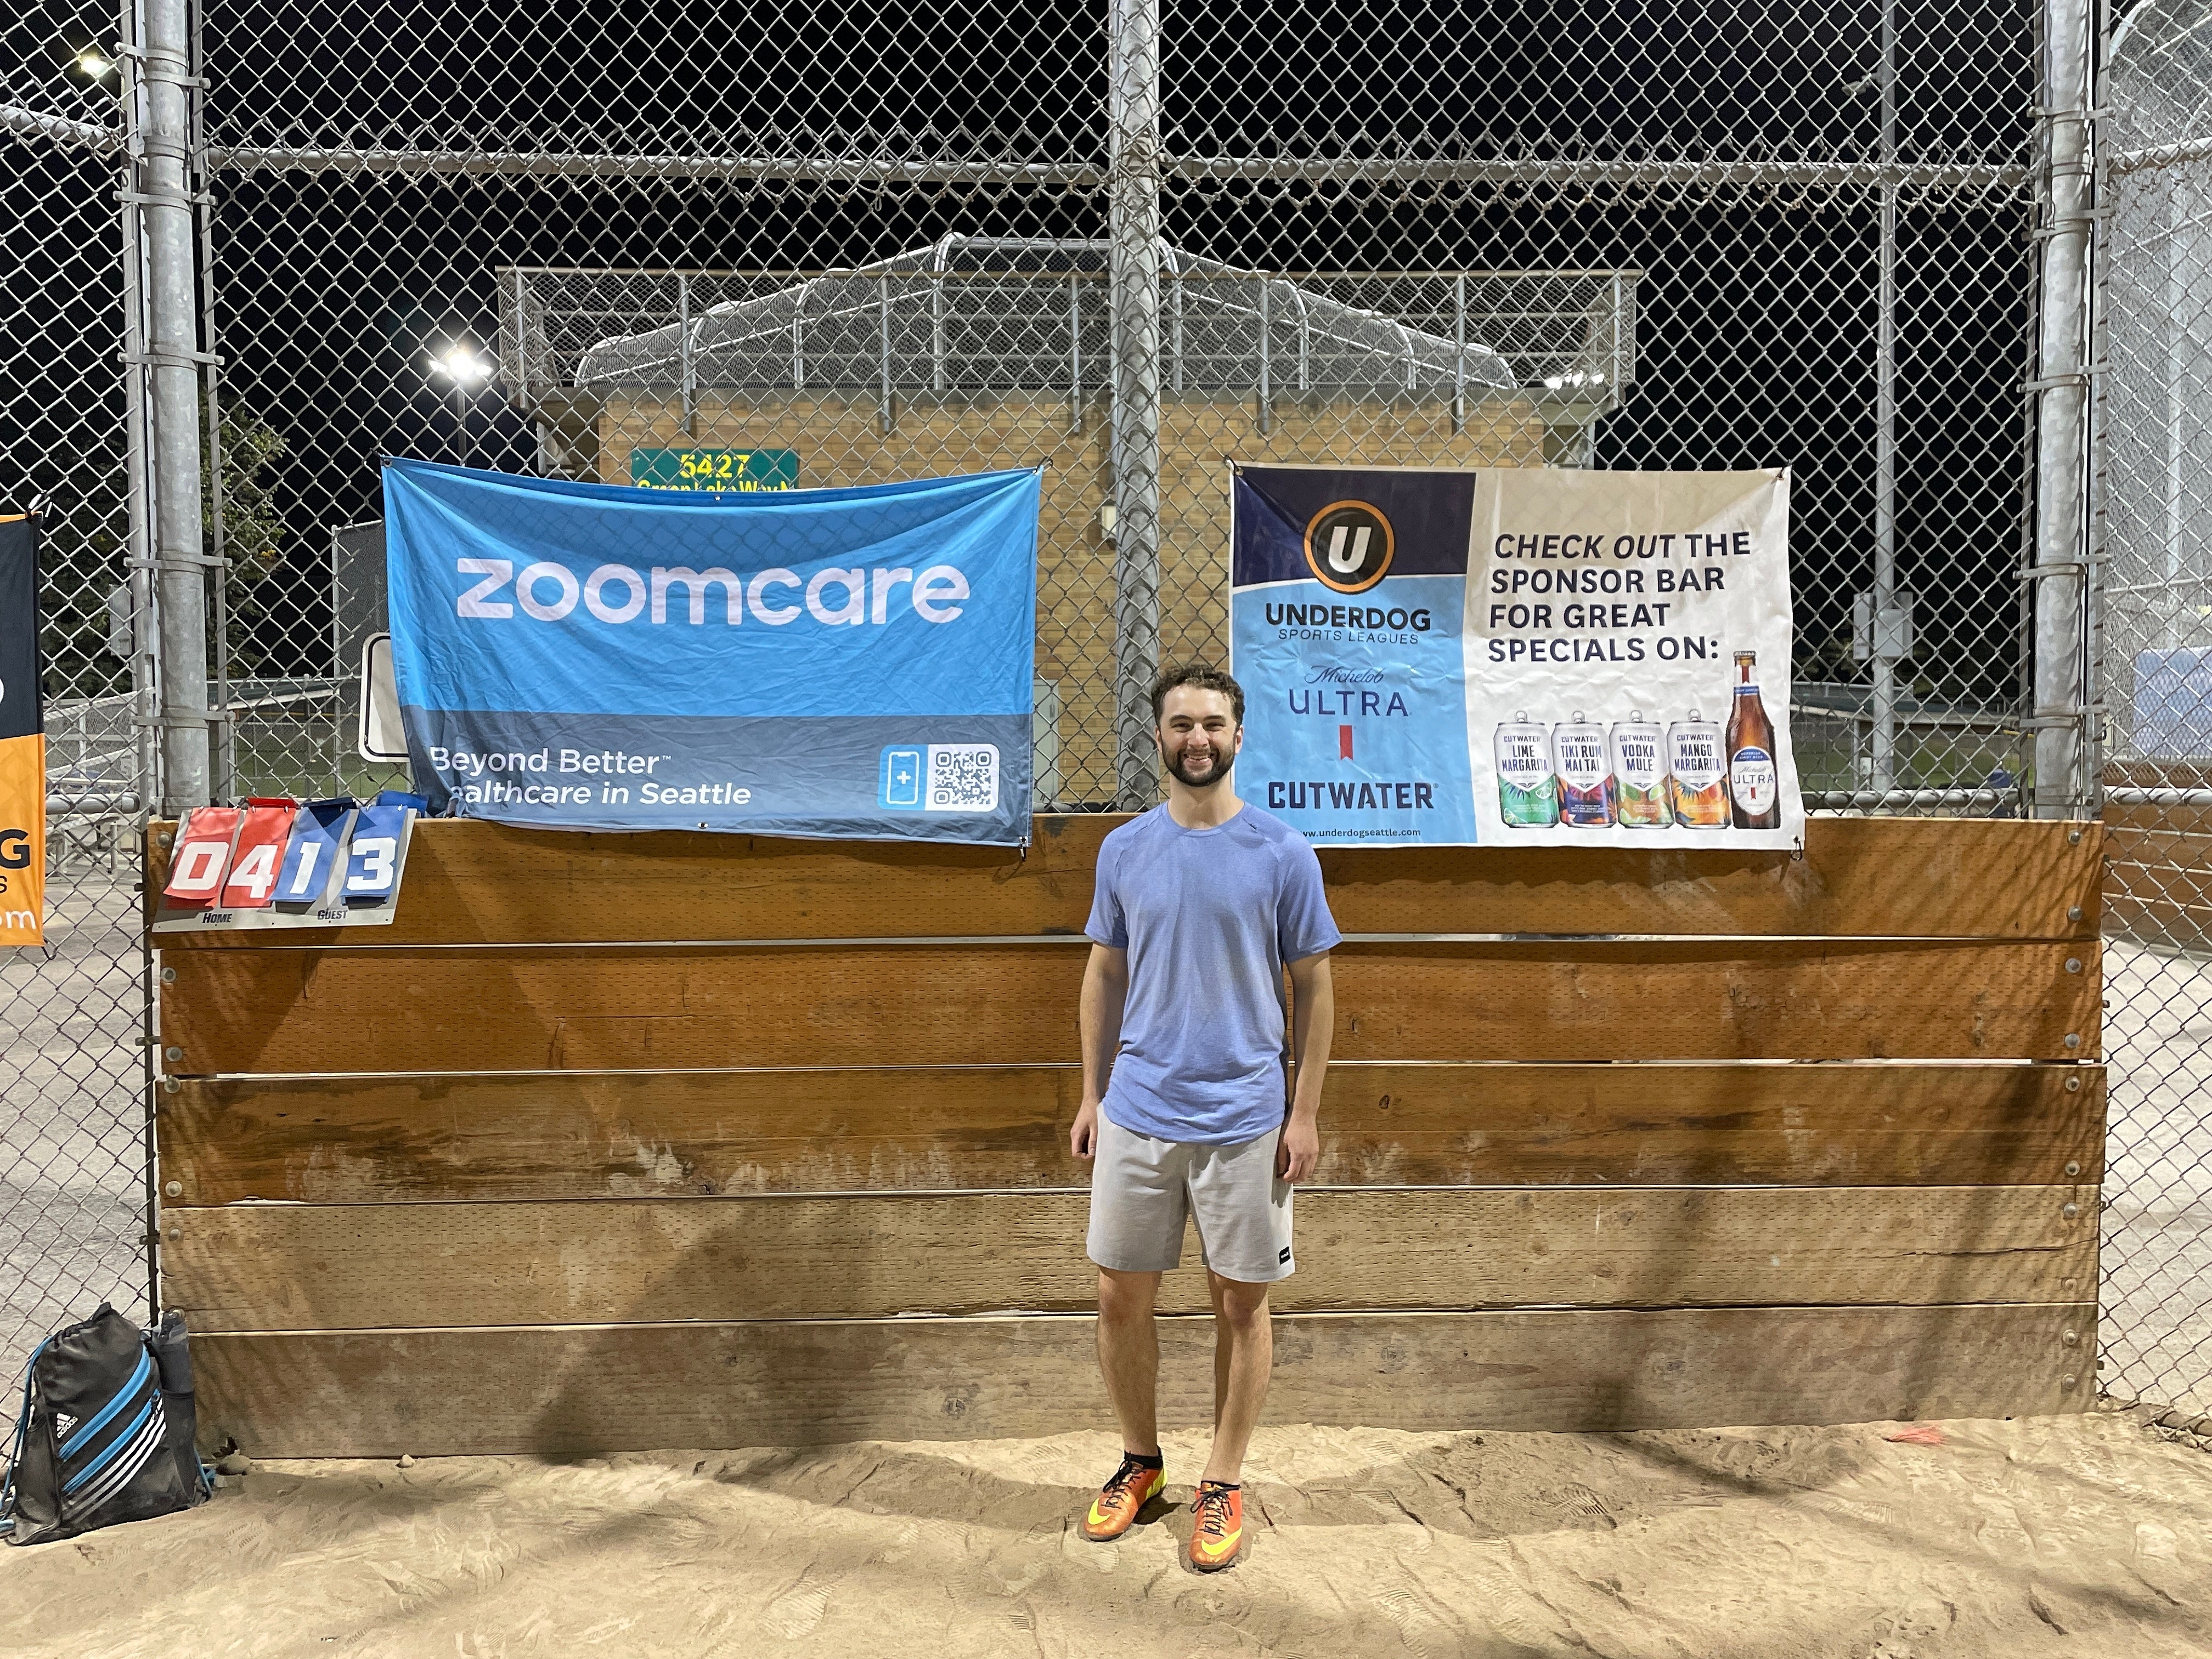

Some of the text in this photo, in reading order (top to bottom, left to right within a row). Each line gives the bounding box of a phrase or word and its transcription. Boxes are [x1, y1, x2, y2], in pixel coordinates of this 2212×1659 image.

[679, 454, 751, 478] 5427
[1495, 531, 1751, 559] CHECK OUT THE
[1491, 567, 1725, 594] SPONSOR BAR
[456, 557, 970, 625] zoomcare
[1266, 602, 1430, 631] UNDERDOG
[1489, 603, 1671, 628] FOR GREAT
[1279, 629, 1419, 645] SPORTS LEAGUES
[1488, 636, 1719, 662] SPECIALS ON:
[1304, 665, 1384, 684] Michelob
[1289, 689, 1409, 716] ULTRA
[1513, 745, 1534, 757] LIME
[1560, 745, 1602, 758] TIKI RUM
[1622, 744, 1655, 758] VODKA
[1680, 744, 1712, 757] MANGO
[430, 746, 548, 777] Beyond
[1502, 759, 1548, 771] MARGARITA
[1565, 759, 1600, 771] MAI TAI
[1627, 758, 1654, 771] MULE
[1674, 758, 1720, 771] MARGARITA
[1734, 774, 1774, 784] ULTRA
[451, 779, 751, 805] althcare in Seattle
